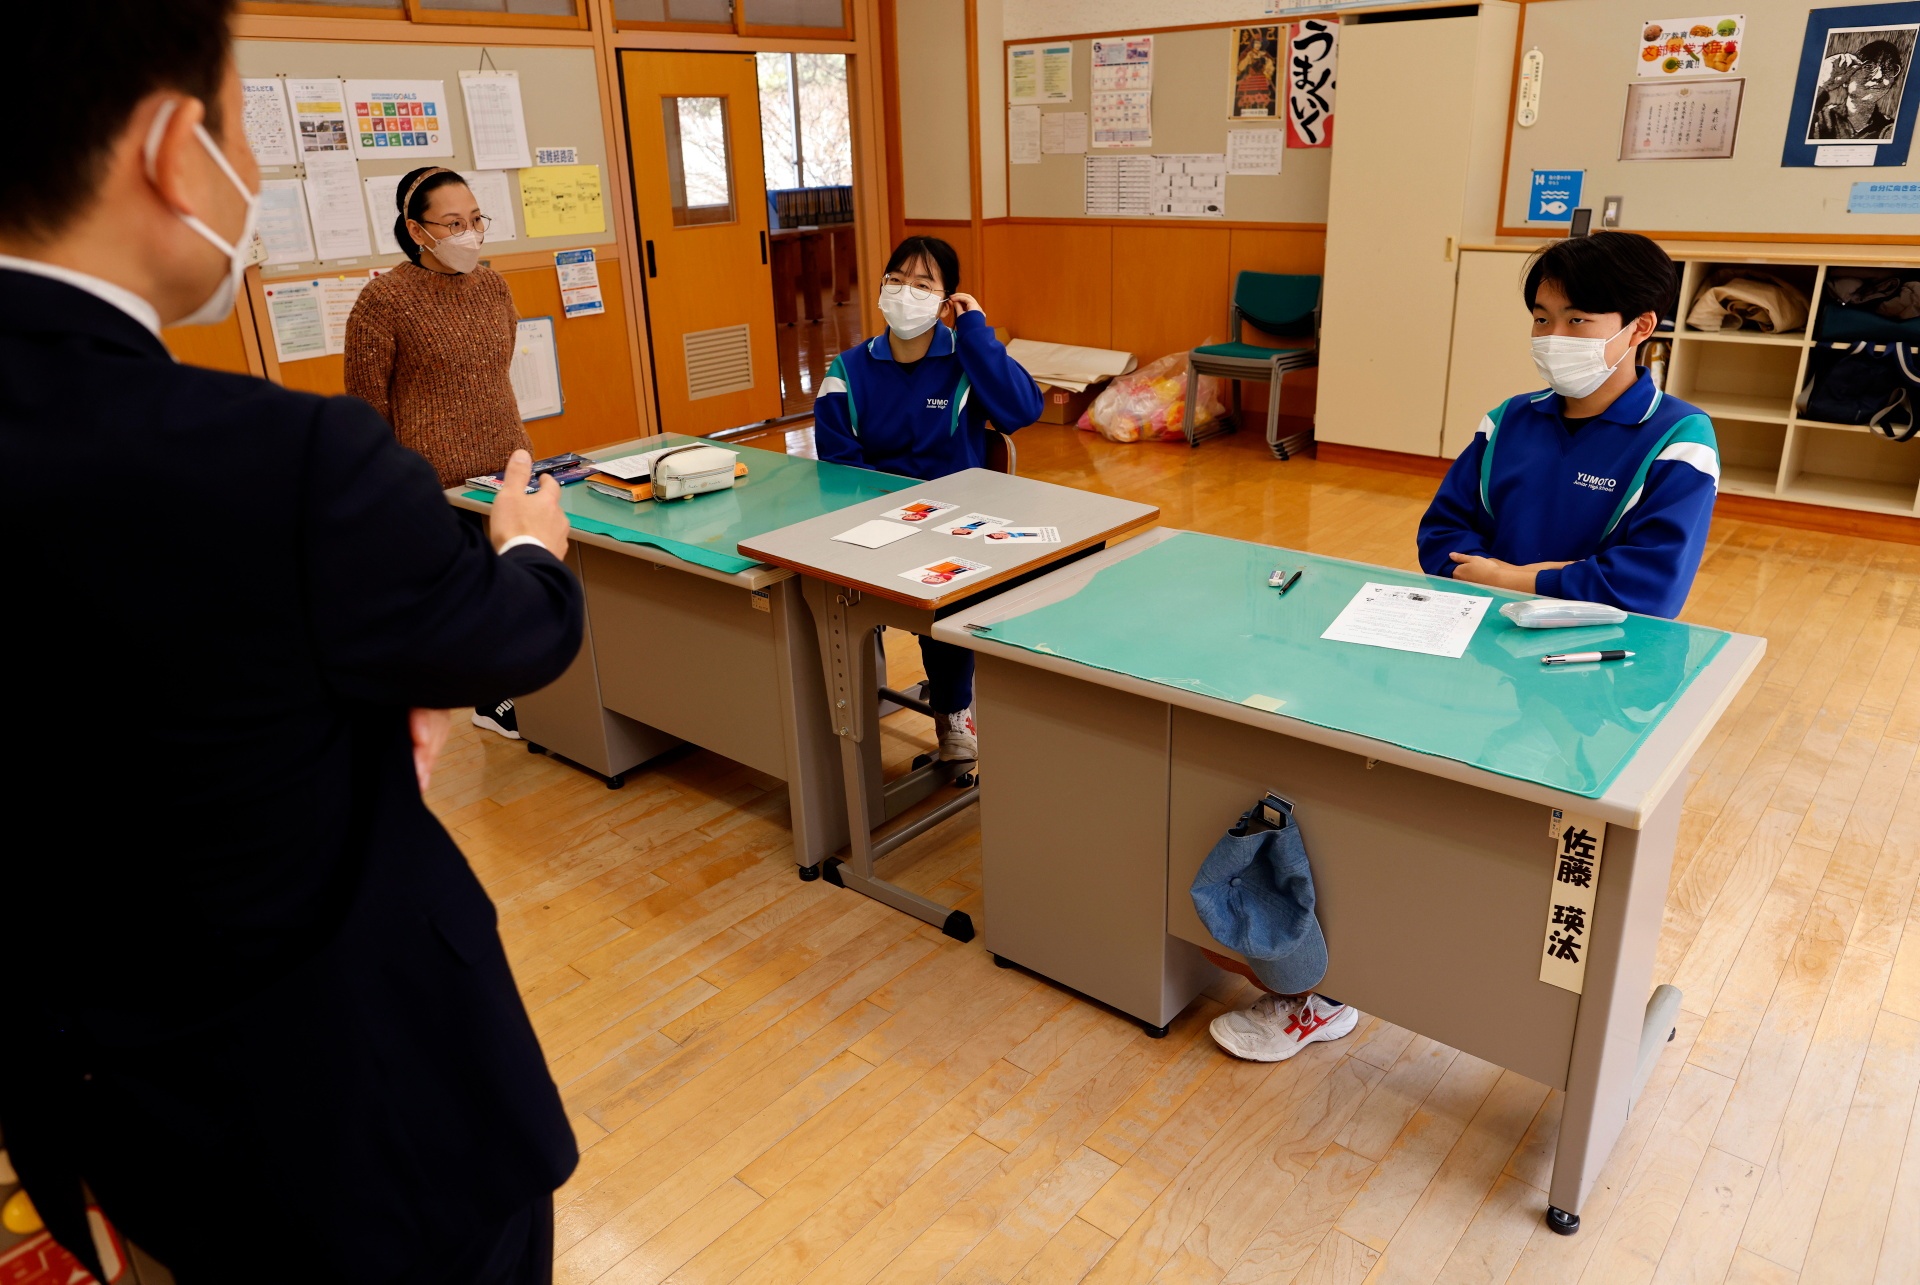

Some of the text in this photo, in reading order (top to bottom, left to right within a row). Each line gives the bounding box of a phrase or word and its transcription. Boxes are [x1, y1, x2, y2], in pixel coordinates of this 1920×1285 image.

[1291, 20, 1333, 144] うまくいく
[538, 149, 575, 164] 避難経路図
[1535, 174, 1545, 186] 14
[1577, 471, 1617, 487] YUMOTO
[1547, 825, 1597, 964] 佐藤 瑛汰
